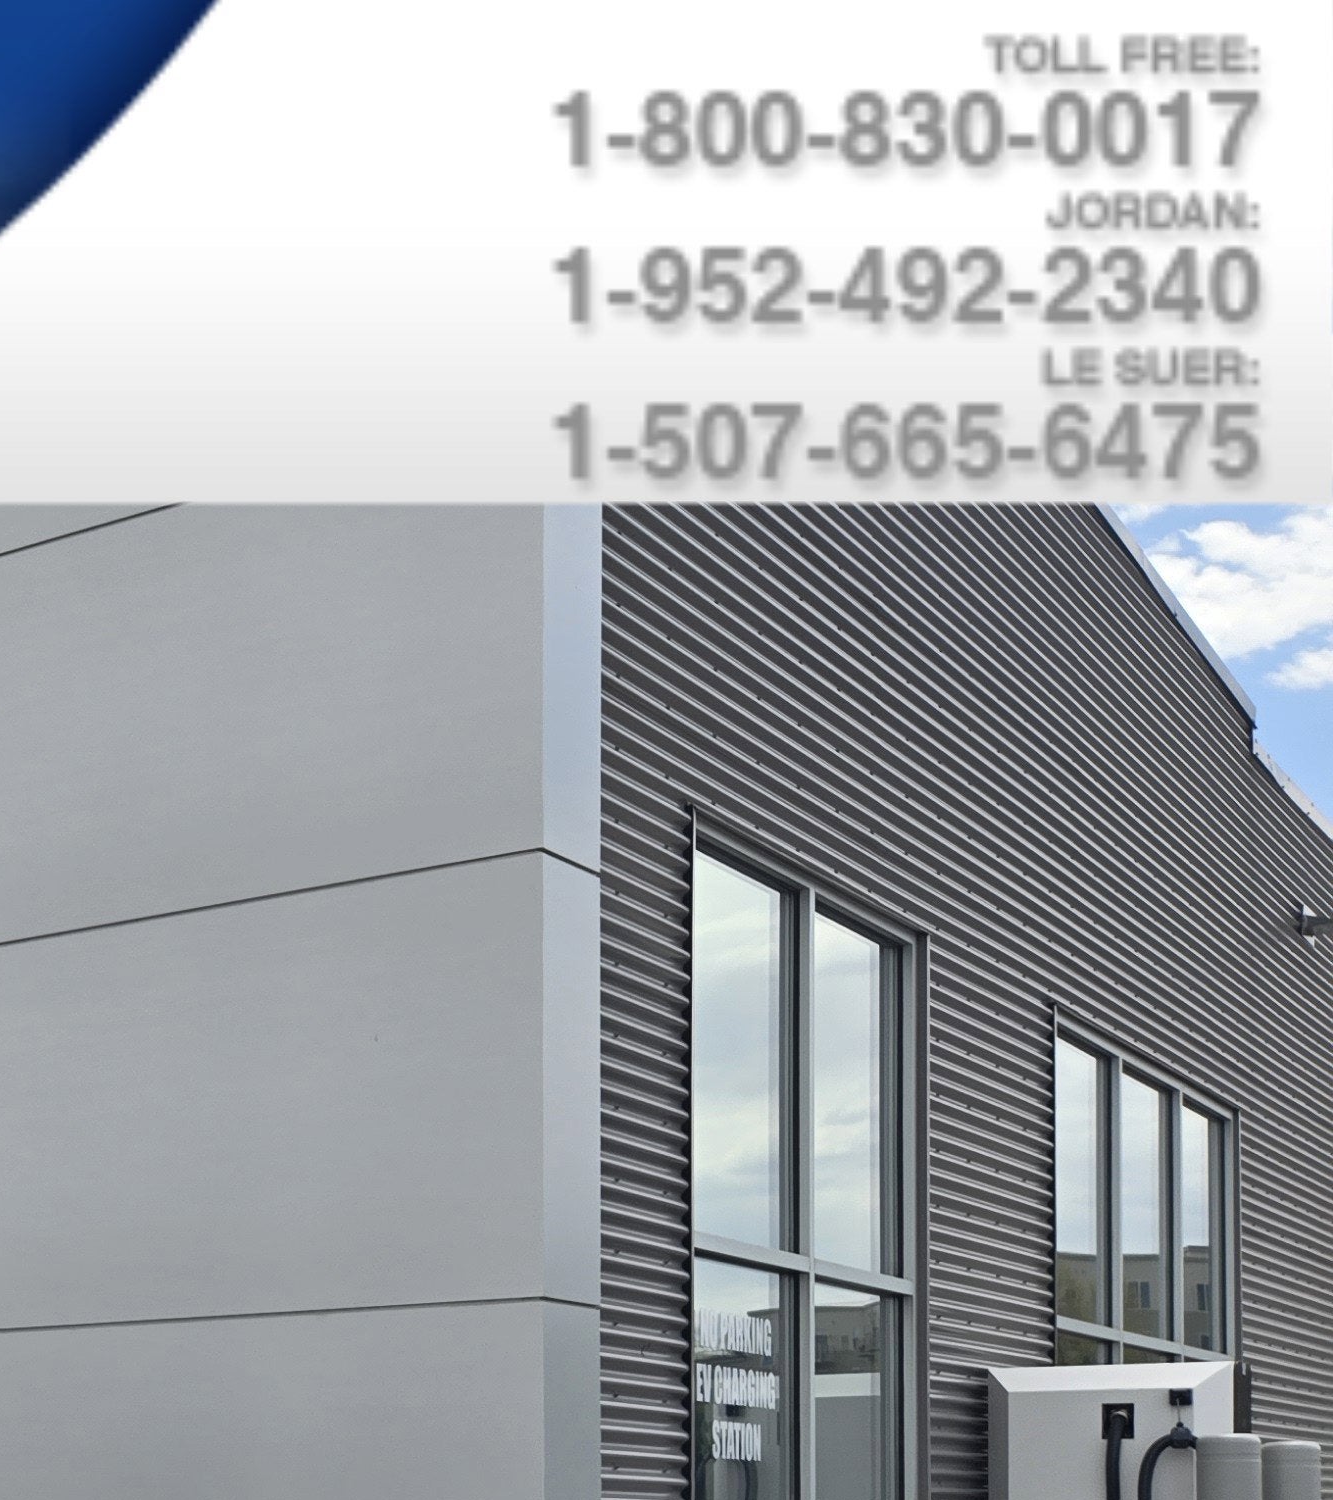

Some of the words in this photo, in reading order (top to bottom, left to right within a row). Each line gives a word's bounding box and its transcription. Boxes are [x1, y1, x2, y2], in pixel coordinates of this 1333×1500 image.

[699, 1309, 719, 1347] NO
[720, 1312, 772, 1357] PARKING
[696, 1363, 712, 1403] EV
[713, 1364, 776, 1410] CHARGING
[711, 1419, 762, 1462] STATION
